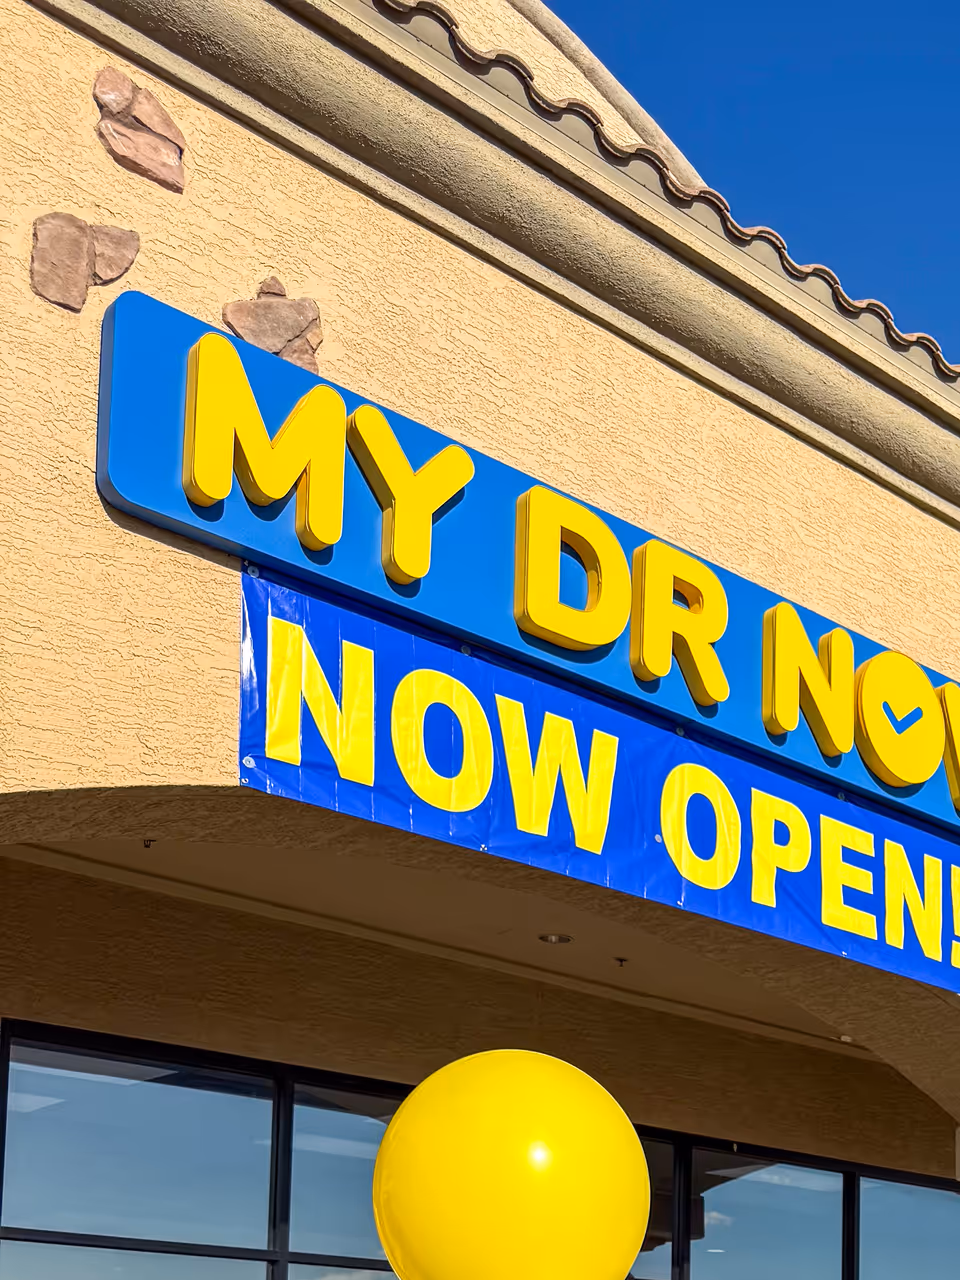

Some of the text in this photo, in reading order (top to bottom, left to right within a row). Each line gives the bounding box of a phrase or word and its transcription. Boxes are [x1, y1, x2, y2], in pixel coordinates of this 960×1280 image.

[182, 331, 475, 583] MY
[513, 485, 730, 707] DR
[264, 614, 619, 855] NOW
